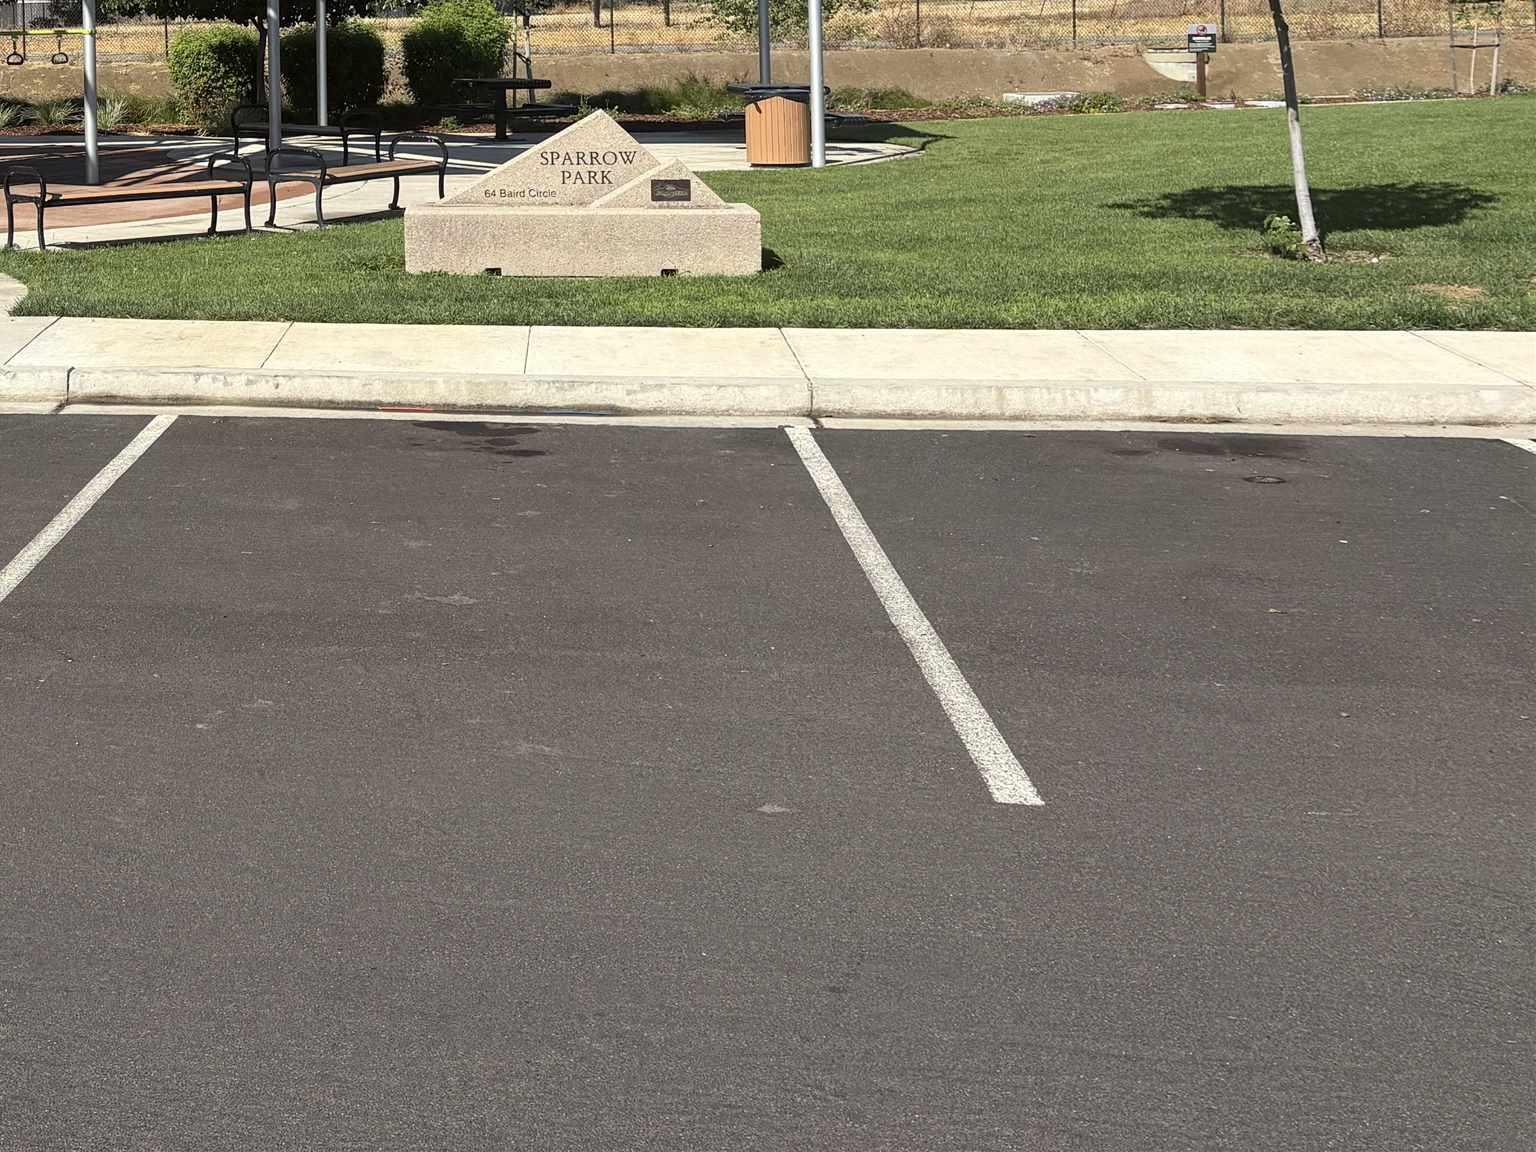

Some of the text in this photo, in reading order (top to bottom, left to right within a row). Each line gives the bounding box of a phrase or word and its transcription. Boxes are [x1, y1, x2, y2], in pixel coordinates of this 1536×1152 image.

[540, 150, 637, 166] SPARROW
[560, 170, 614, 185] PARK
[484, 188, 557, 198] 64 Baird Circle
